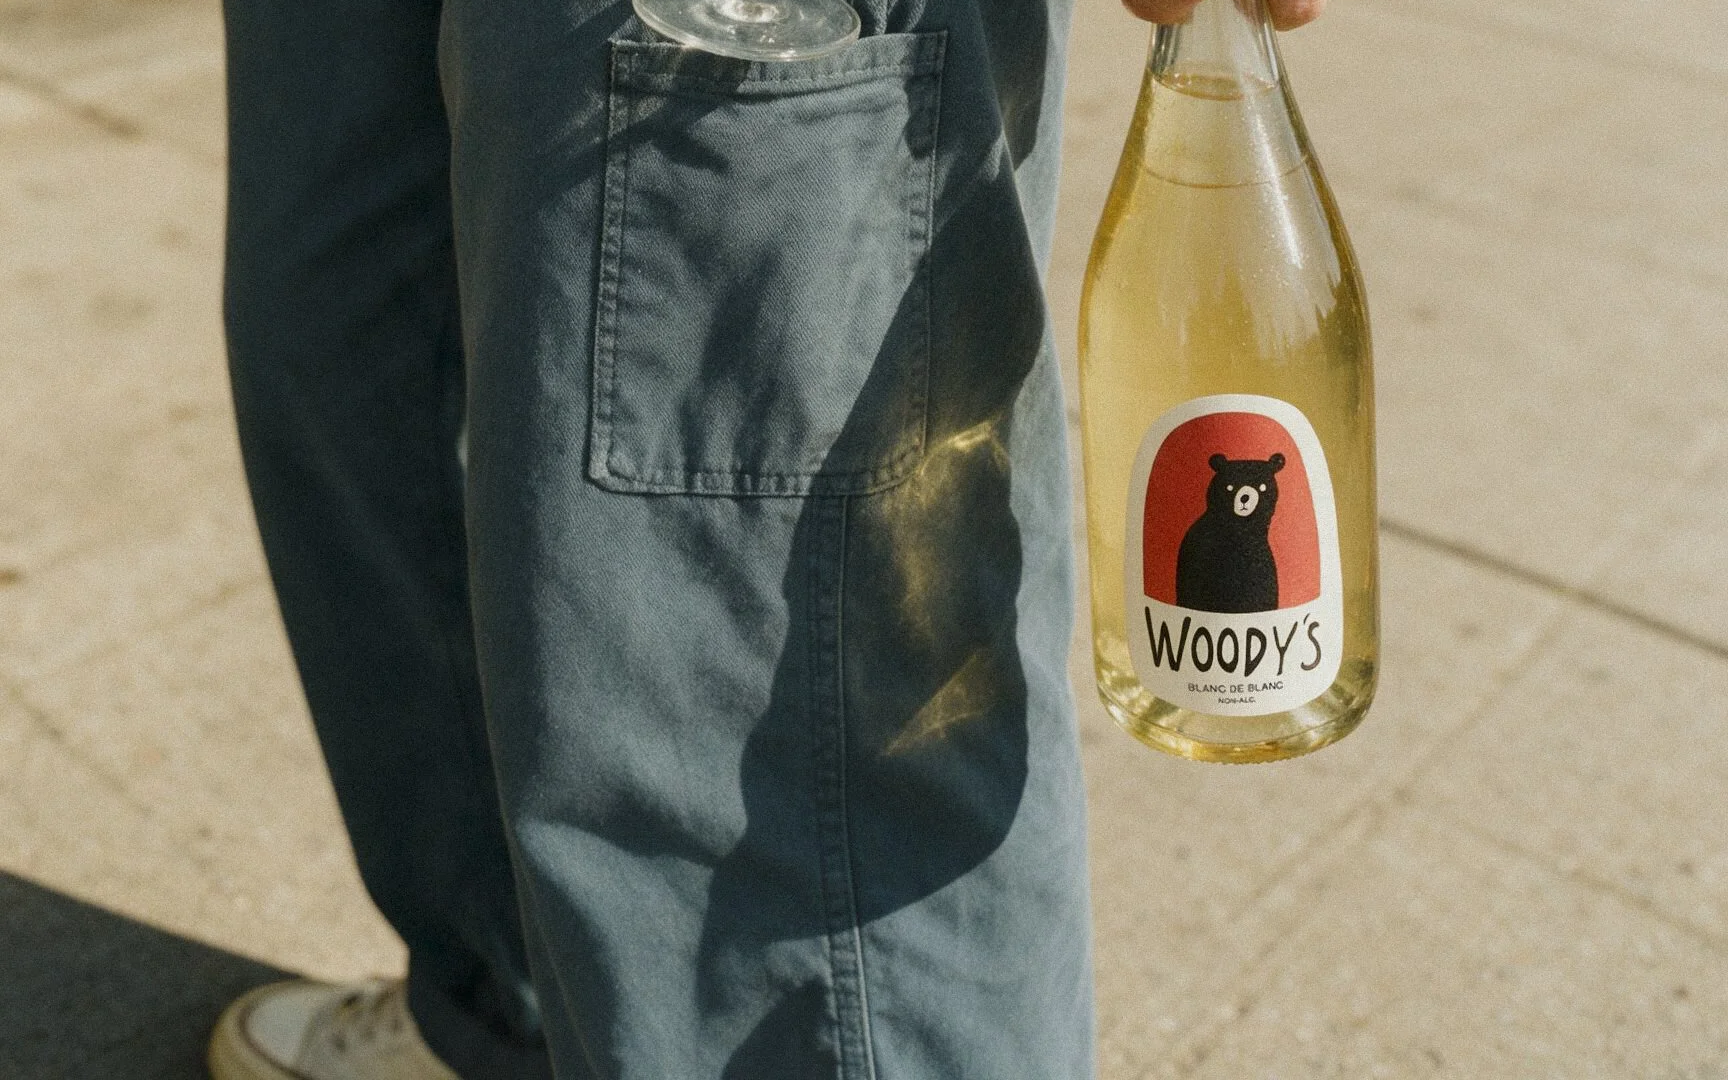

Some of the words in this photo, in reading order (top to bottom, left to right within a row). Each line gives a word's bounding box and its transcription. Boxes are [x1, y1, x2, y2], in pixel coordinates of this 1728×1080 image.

[1145, 606, 1321, 677] WOODY'S
[1188, 682, 1226, 694] BLANC
[1230, 684, 1244, 694] DE
[1247, 681, 1284, 693] BLANC
